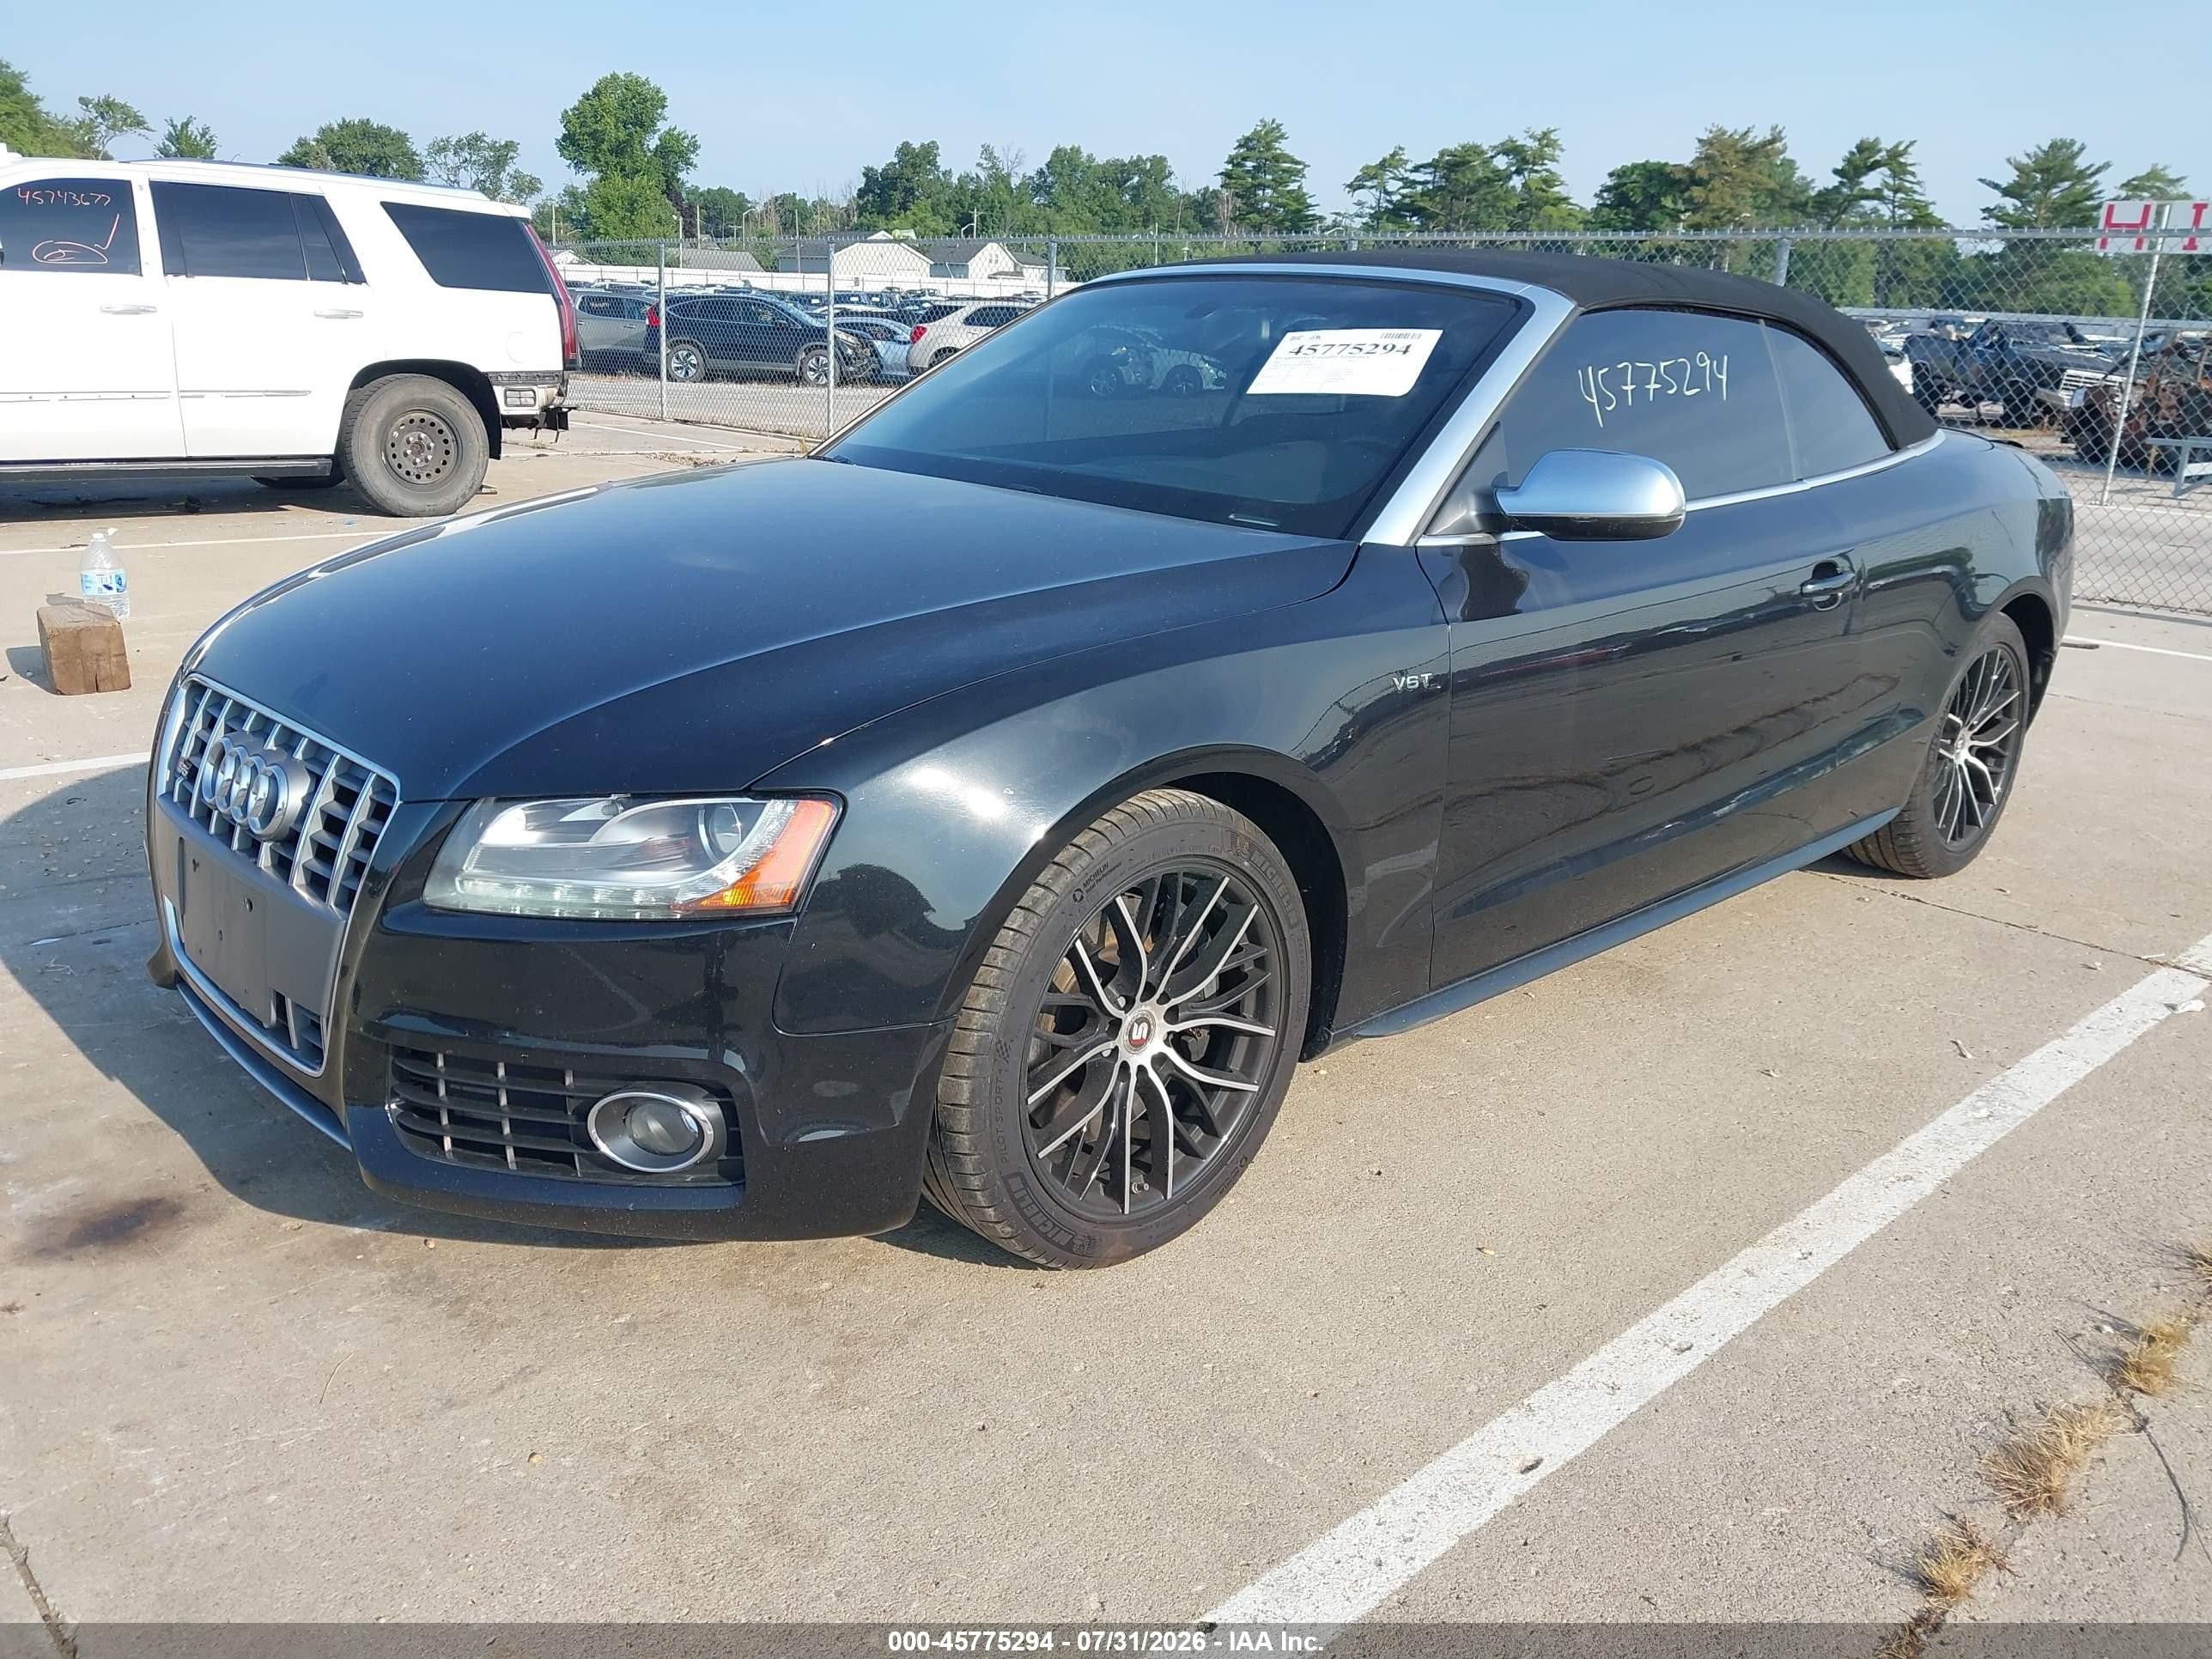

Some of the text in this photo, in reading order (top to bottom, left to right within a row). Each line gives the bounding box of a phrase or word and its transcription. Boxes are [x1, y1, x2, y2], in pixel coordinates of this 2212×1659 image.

[17, 187, 112, 207] 45743677
[1288, 343, 1413, 356] 45775294
[1577, 350, 1729, 428] 45775294
[1392, 672, 1433, 693] V6T
[1083, 860, 1110, 889] MICHELIN
[995, 1077, 1004, 1122] SPORT
[995, 1128, 1009, 1164] PILOT
[1007, 1176, 1074, 1247] MICHELIN
